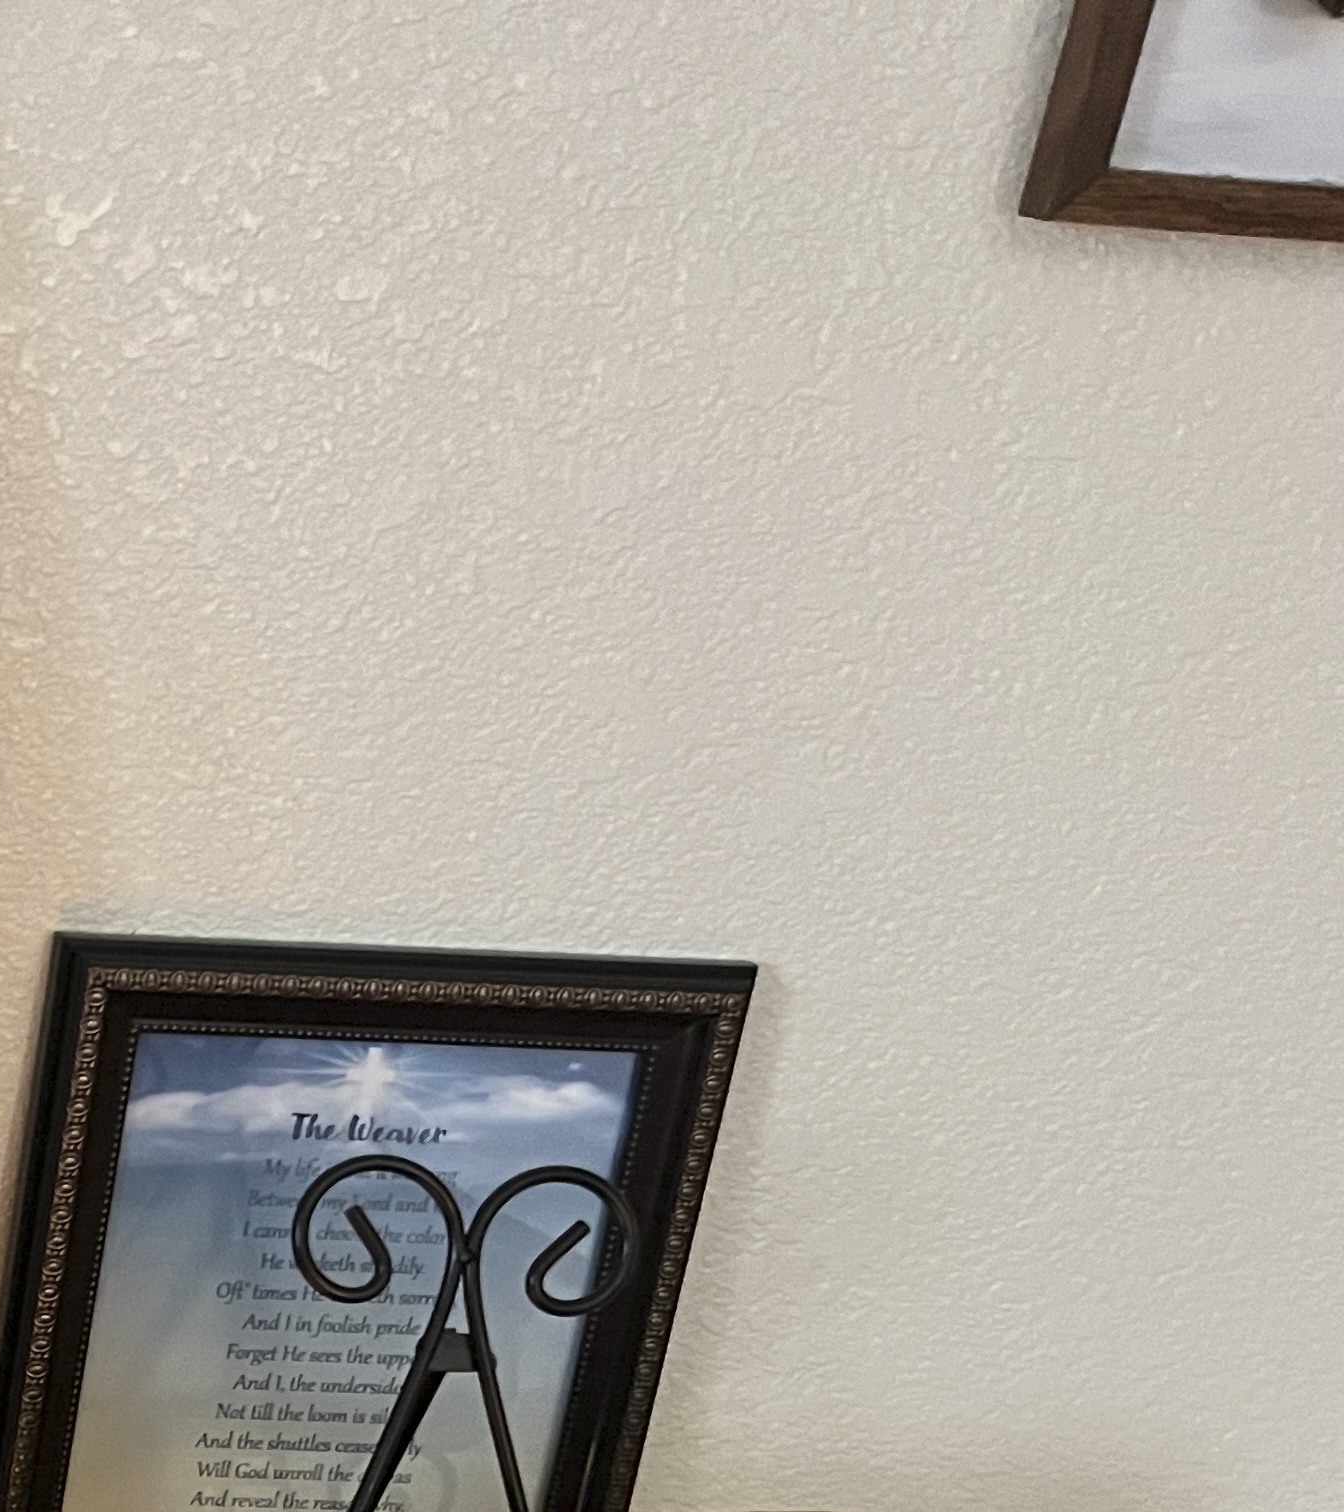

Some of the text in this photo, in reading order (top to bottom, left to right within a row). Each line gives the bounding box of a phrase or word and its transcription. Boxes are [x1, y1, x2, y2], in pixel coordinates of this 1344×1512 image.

[291, 1112, 447, 1144] The Weaver
[254, 1284, 296, 1301] times
[242, 1313, 422, 1339] And I in foolish pride
[226, 1343, 373, 1366] Forget He sees the
[232, 1373, 272, 1390] And
[289, 1373, 316, 1392] the
[215, 1402, 365, 1423] Not till the loom is
[195, 1431, 331, 1452] And the shuttles
[197, 1460, 353, 1483] Will God unroll the
[189, 1489, 310, 1510] And reveal the
